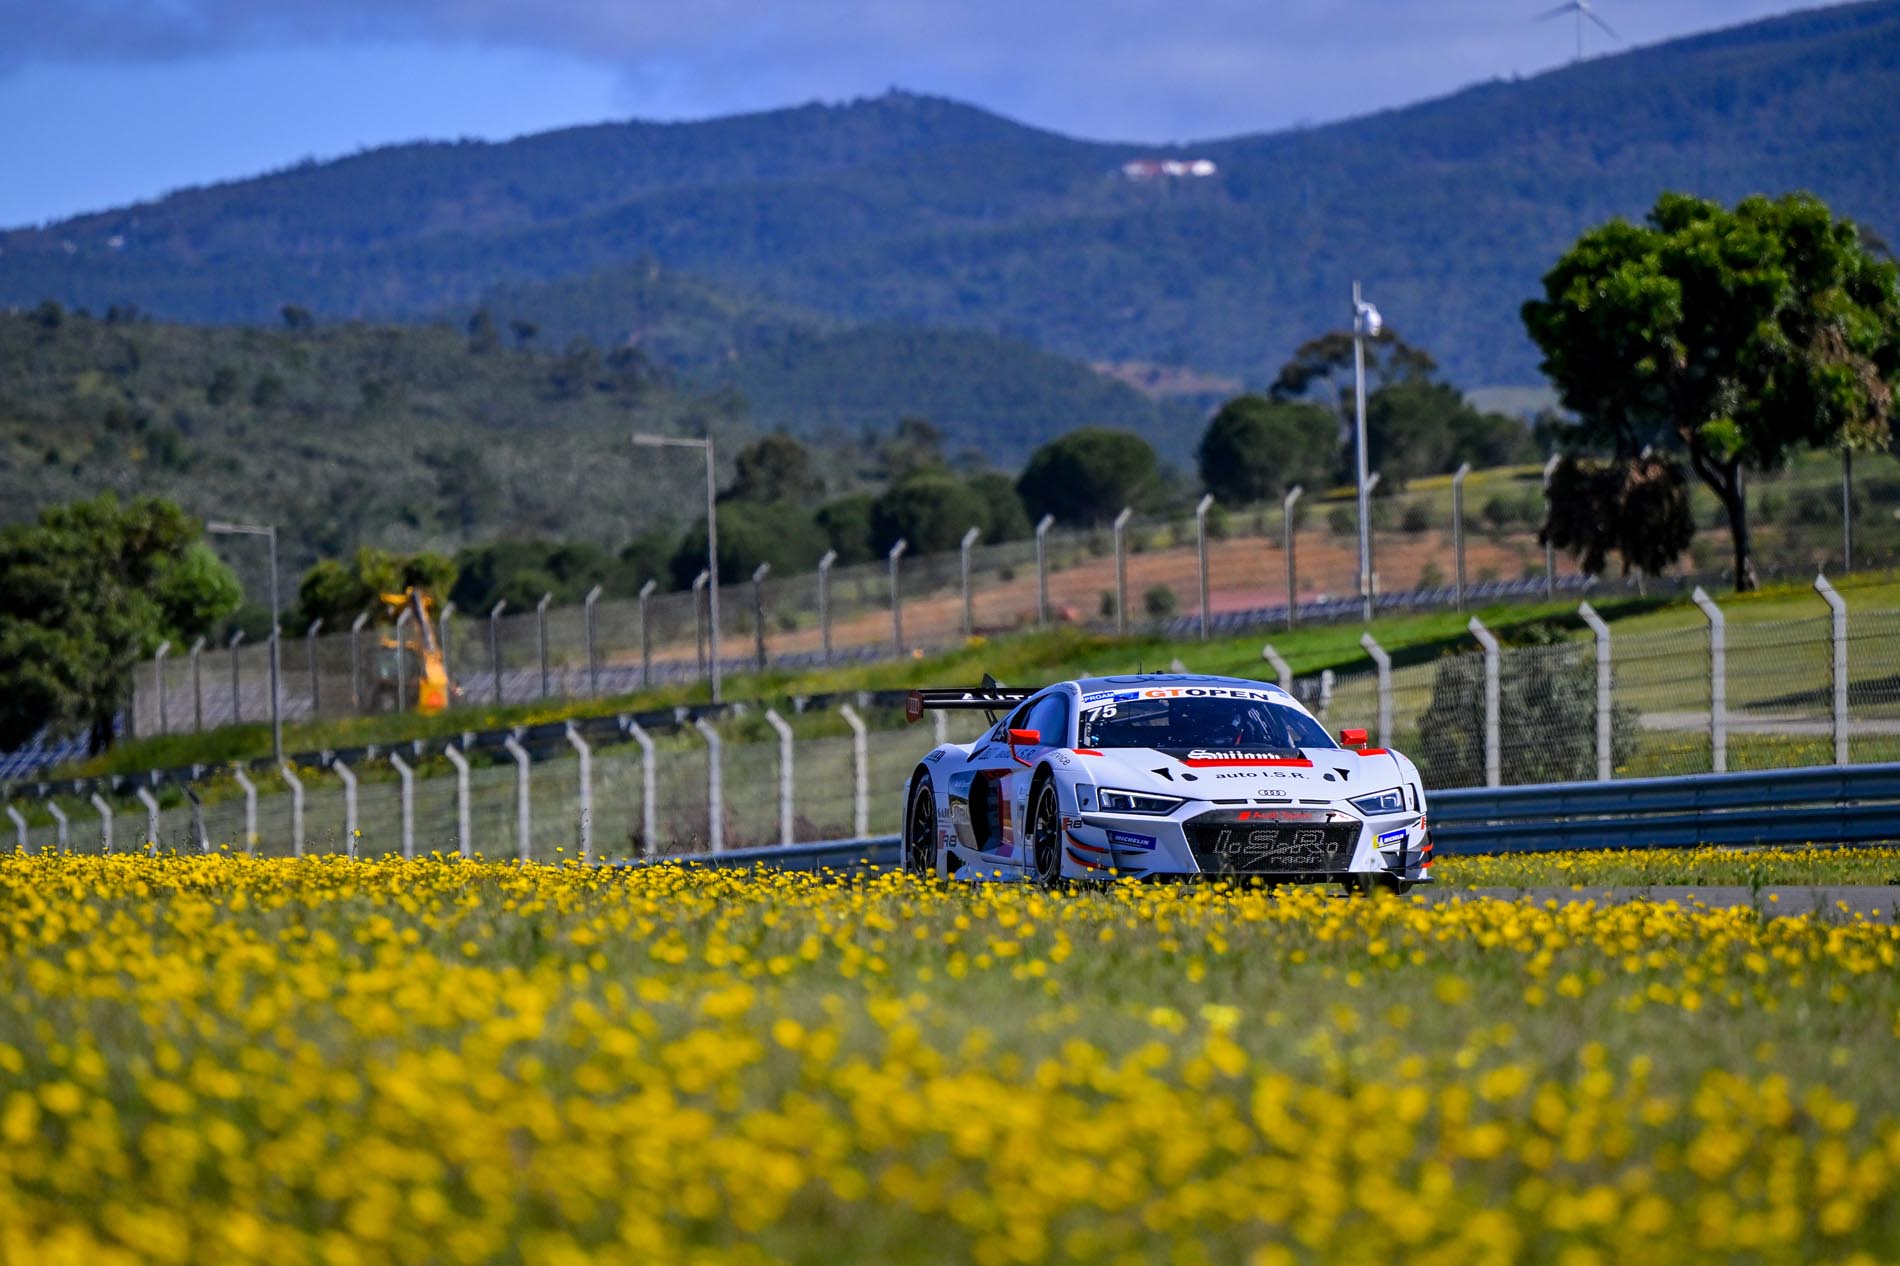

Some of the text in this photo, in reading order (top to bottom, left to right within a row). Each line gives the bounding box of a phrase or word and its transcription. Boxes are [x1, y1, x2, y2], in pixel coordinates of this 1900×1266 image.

[1084, 692, 1115, 702] PROAM
[1087, 703, 1118, 722] 75
[1216, 771, 1310, 780] auto I.S.R.
[1115, 834, 1150, 846] MICHELIN
